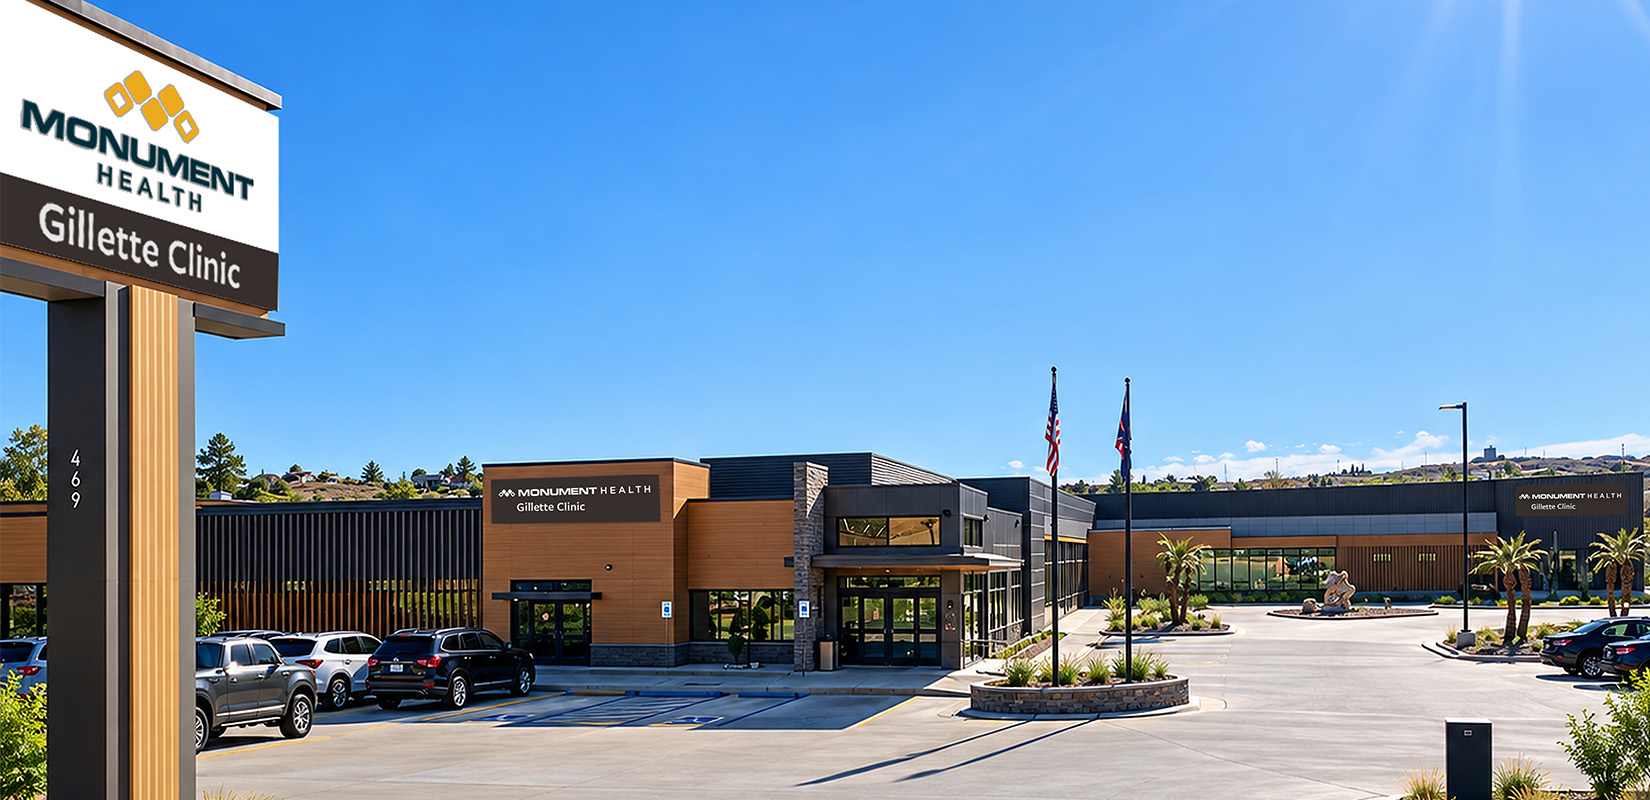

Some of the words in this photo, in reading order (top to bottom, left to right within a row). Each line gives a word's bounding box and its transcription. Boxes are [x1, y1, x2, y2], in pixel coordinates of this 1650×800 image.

[21, 99, 254, 201] MONUMENT
[97, 162, 202, 212] HEALTH
[39, 202, 159, 268] Gillette
[168, 240, 241, 289] Clinic
[70, 449, 81, 508] 469
[518, 487, 597, 497] MONUMENT
[600, 485, 651, 495] HEALTH
[516, 502, 554, 512] Gillette
[557, 501, 585, 511] Clinic
[1557, 502, 1576, 510] Clinic
